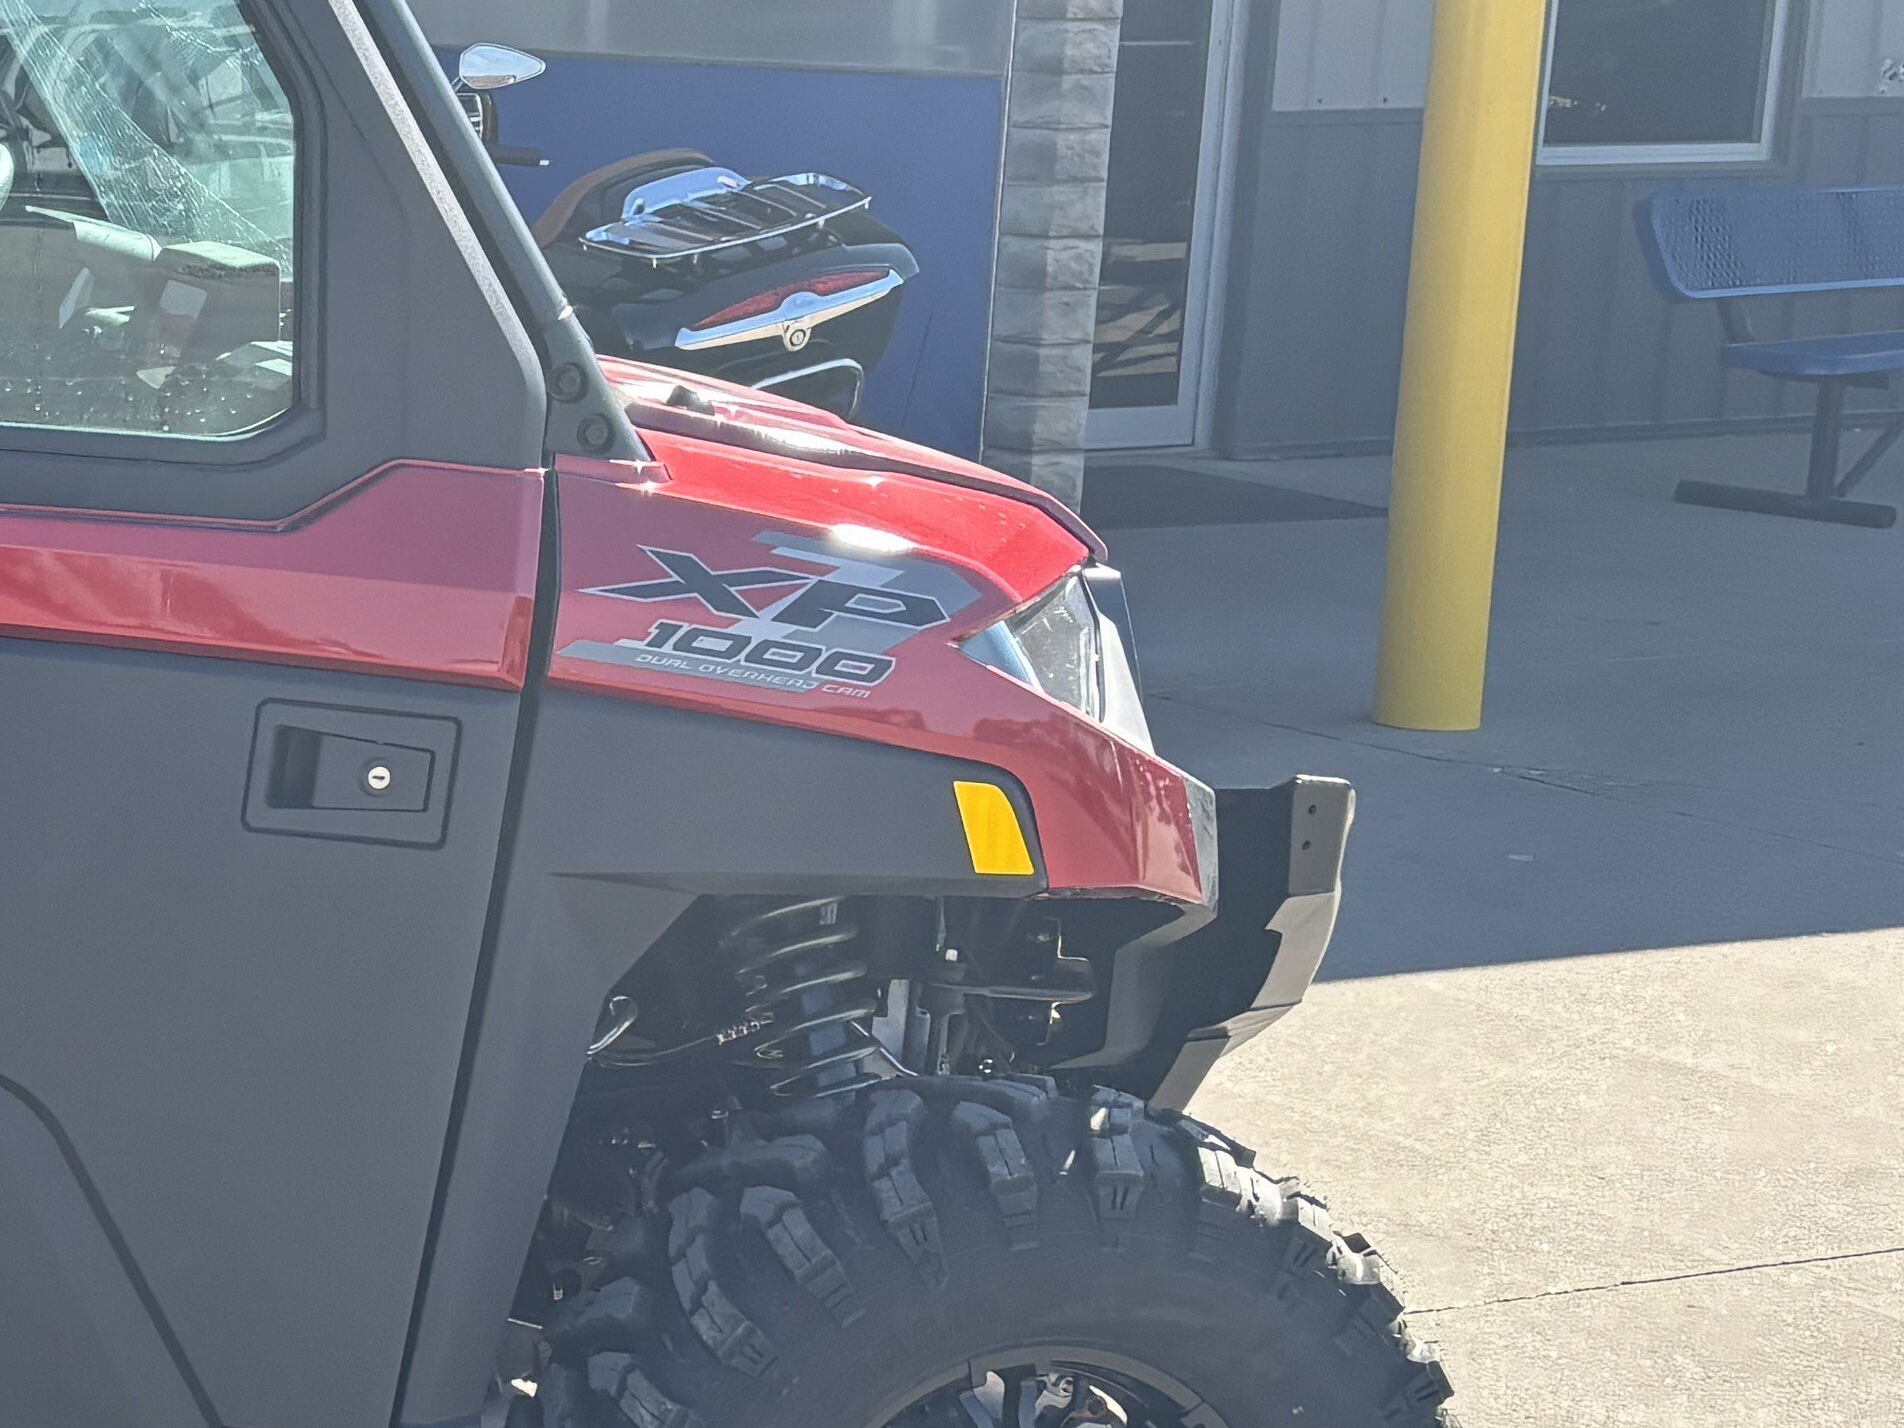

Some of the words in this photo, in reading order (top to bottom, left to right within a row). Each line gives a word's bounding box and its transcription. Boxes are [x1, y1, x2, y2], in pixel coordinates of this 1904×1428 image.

[576, 544, 951, 631] XP
[635, 653, 698, 670] DUAL
[698, 663, 818, 690] OVERHEAD
[820, 683, 872, 699] CAM
[645, 619, 897, 687] 1000
